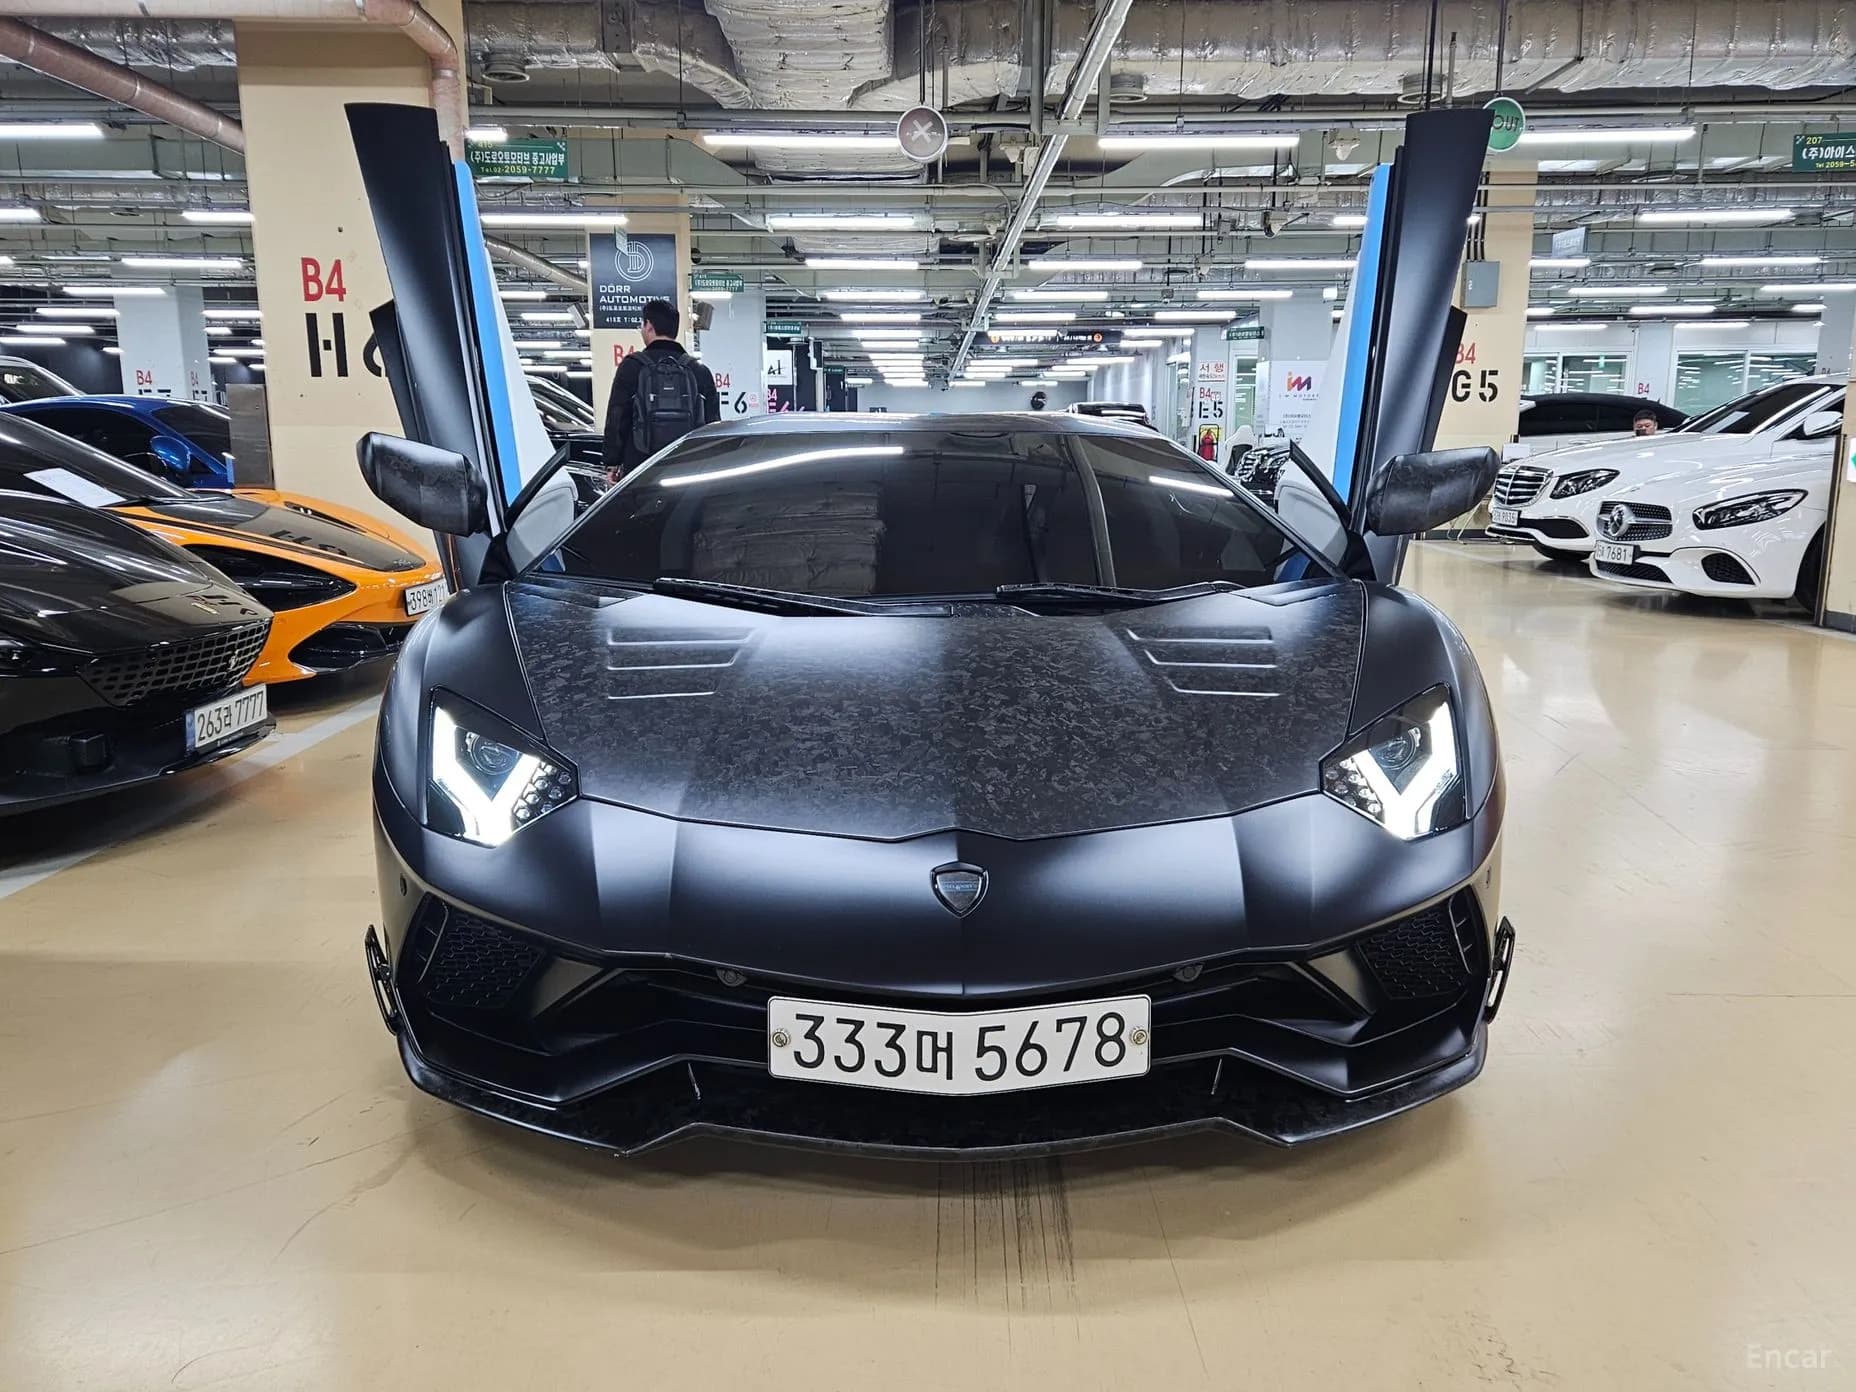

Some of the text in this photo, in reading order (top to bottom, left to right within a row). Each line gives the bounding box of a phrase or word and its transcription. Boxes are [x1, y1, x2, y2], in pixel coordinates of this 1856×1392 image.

[1493, 114, 1519, 132] OUT
[1806, 136, 1822, 145] 207
[301, 257, 346, 301] B4
[136, 370, 152, 385] B4
[1638, 383, 1650, 395] B4
[197, 704, 232, 742] 263라
[235, 690, 264, 726] 7777
[793, 1012, 1126, 1082] 333머 5678
